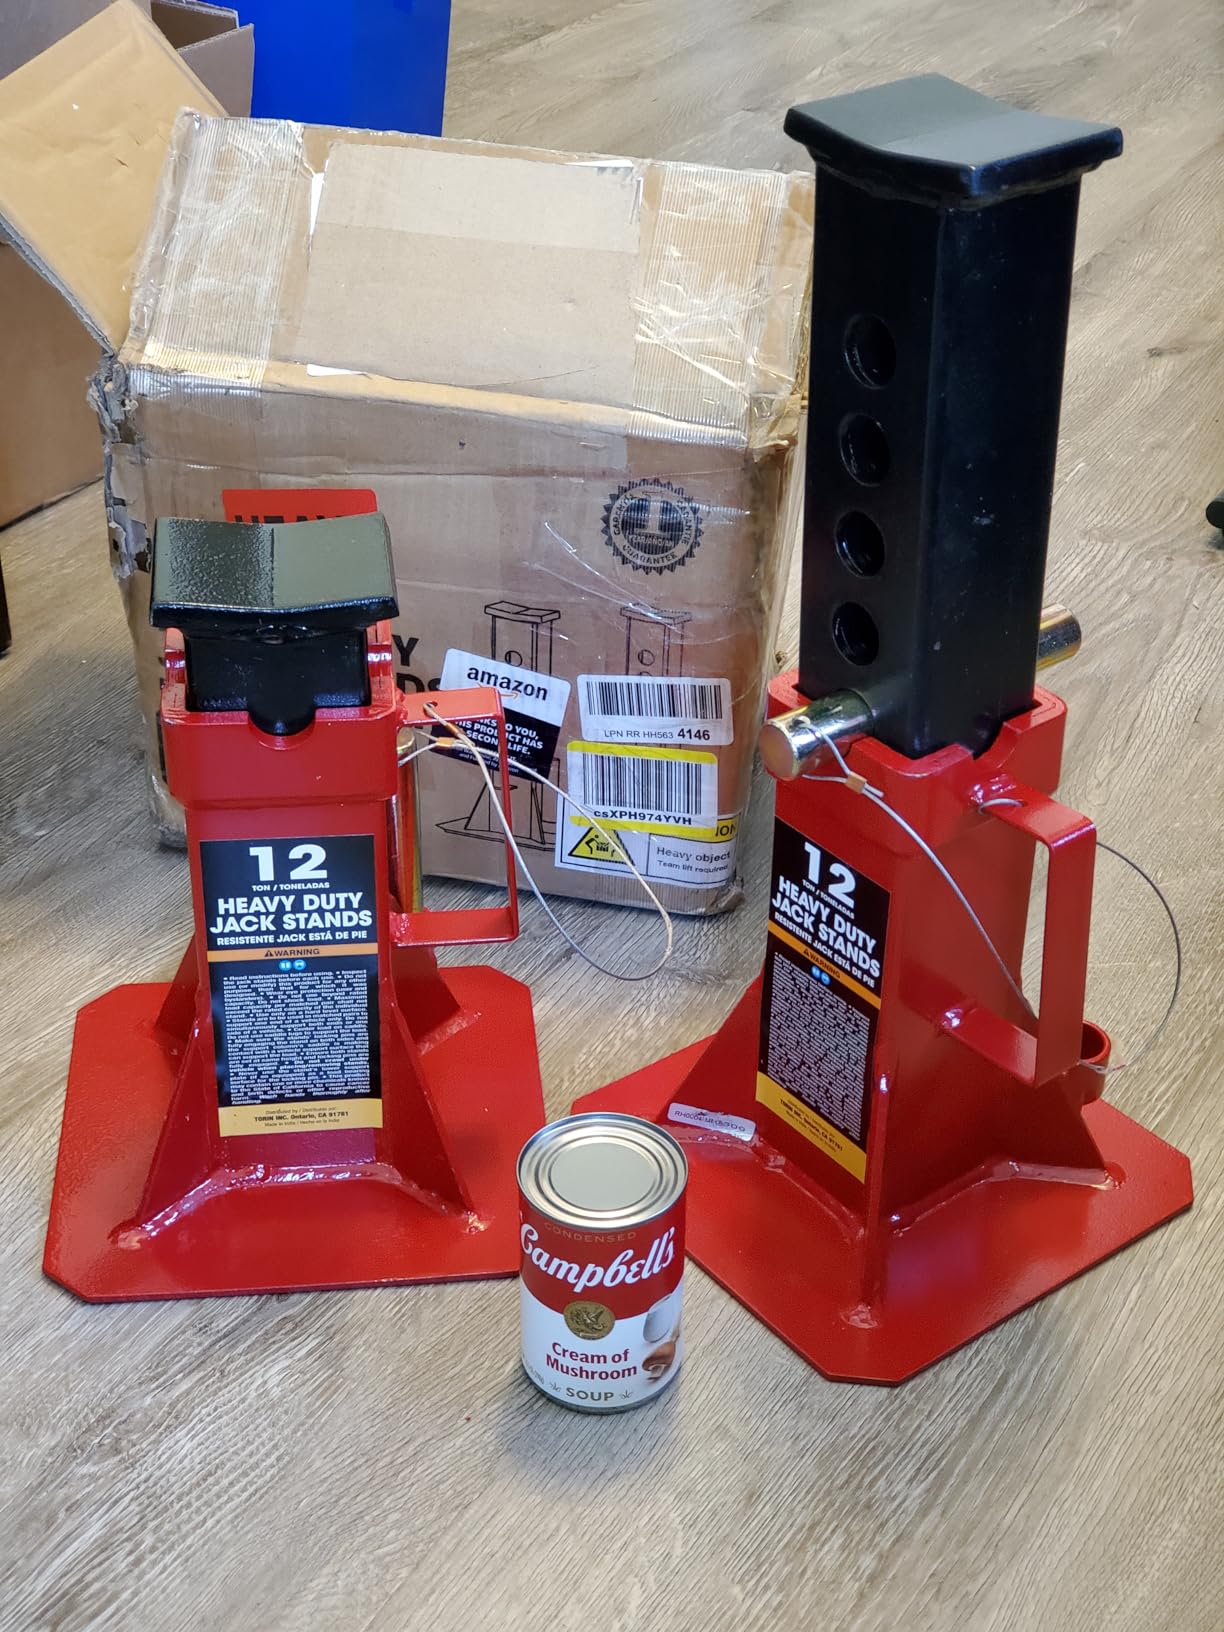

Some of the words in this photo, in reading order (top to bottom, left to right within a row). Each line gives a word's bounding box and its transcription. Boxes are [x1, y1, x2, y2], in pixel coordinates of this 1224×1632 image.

[467, 667, 548, 701] amazon
[466, 730, 499, 746] SECON
[508, 744, 531, 755] LIFE.
[515, 726, 540, 740] YOU,
[523, 737, 544, 750] HAS
[604, 730, 624, 739] LPN
[626, 730, 641, 739] RR
[643, 731, 674, 740] HH563
[677, 728, 711, 742] 4146
[657, 847, 693, 862] Heavy
[695, 850, 731, 864] object
[658, 860, 681, 870] Team
[682, 863, 694, 872] lift
[280, 882, 330, 891] TONELADAS
[218, 895, 296, 915] HEAVY
[303, 892, 363, 911] DUTY
[802, 879, 816, 893] TON
[820, 891, 855, 920] TONELADAS
[210, 914, 277, 934] JACK
[283, 910, 373, 930] STANDS
[779, 875, 831, 921] HEAVY
[834, 913, 877, 954] DUTY
[217, 935, 275, 946] RESISTENTE
[277, 933, 307, 943] JACK
[309, 930, 333, 941] ESTÁ
[336, 932, 350, 940] DE
[352, 931, 368, 939] PIE
[772, 893, 815, 933] JACK
[818, 923, 881, 978] STANDS
[274, 948, 321, 957] WARNING
[774, 912, 813, 944] RESISTENTE
[813, 939, 833, 959] JACK
[852, 967, 863, 980] DE
[863, 975, 876, 989] PIE
[809, 953, 842, 979] WARNING
[544, 1222, 638, 1244] CONDENSED
[520, 1223, 676, 1294] Campbell's
[552, 1341, 607, 1365] Cream
[612, 1349, 630, 1364] of
[546, 1354, 638, 1381] Mushroom
[566, 1387, 615, 1402] SOUP
